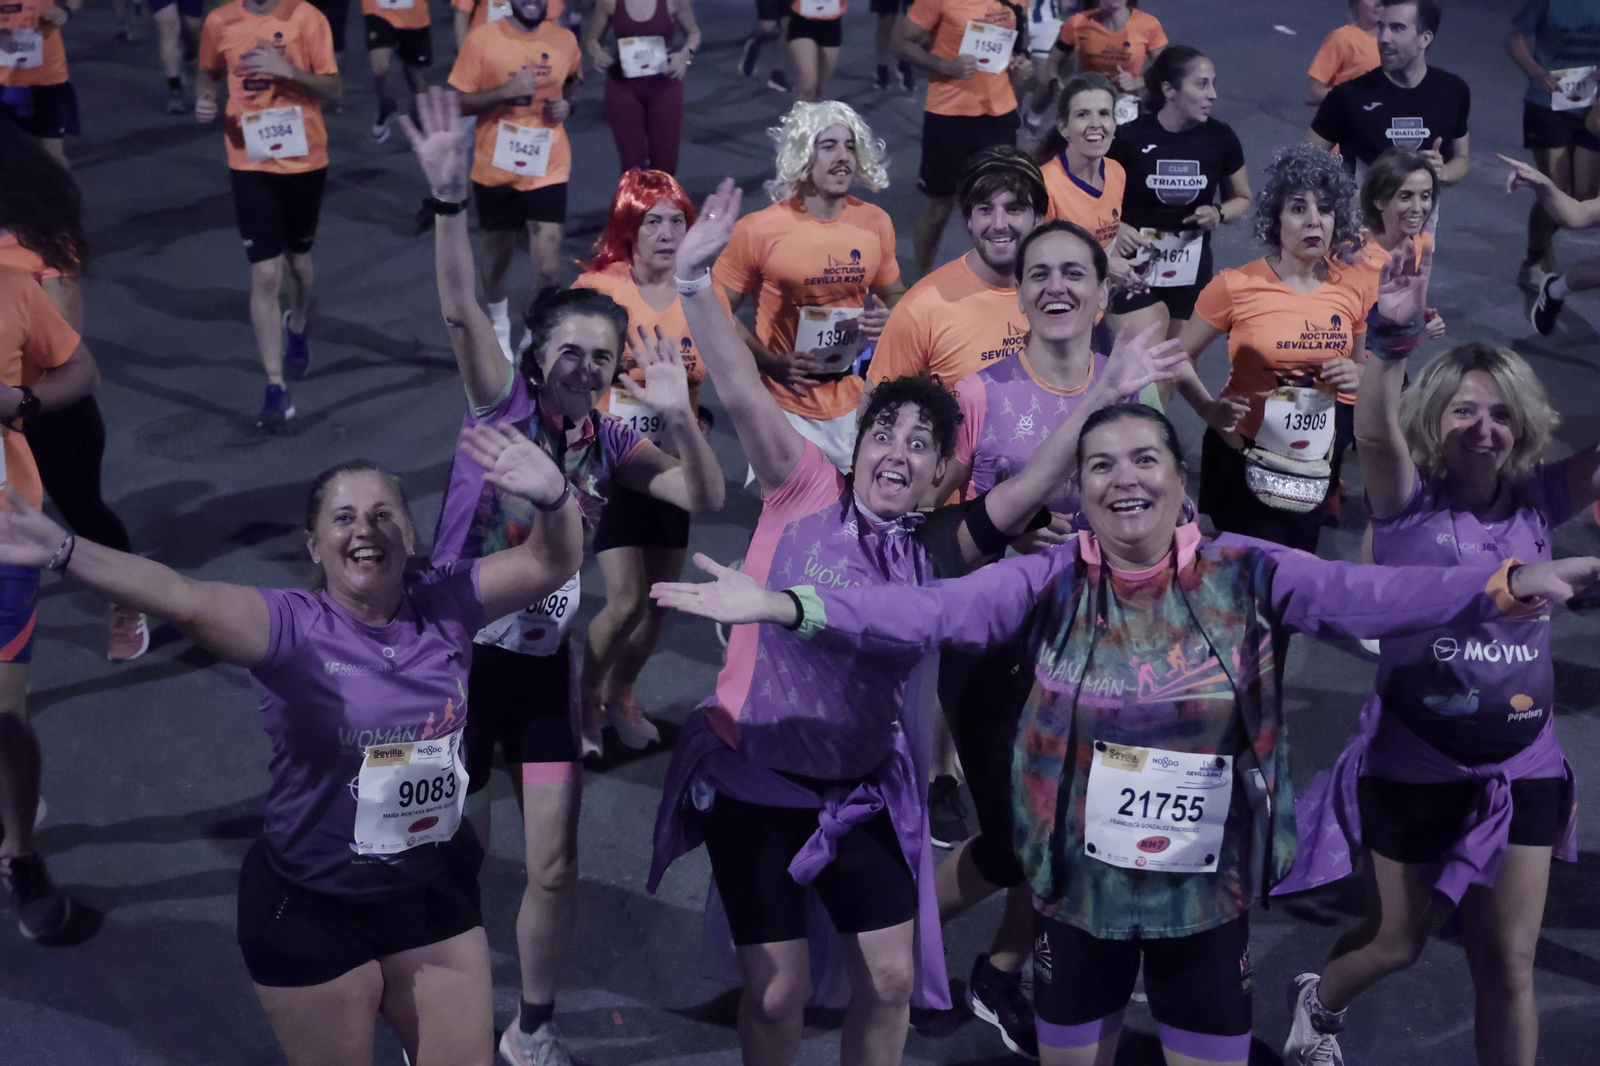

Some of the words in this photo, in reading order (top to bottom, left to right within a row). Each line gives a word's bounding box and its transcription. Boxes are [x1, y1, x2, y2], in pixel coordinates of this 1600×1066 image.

[975, 38, 1003, 54] 11549
[258, 124, 293, 140] 13384
[509, 140, 541, 156] 15424
[1169, 165, 1189, 173] CLUB
[1152, 177, 1203, 187] TRIATLÓN
[823, 266, 866, 275] NOCTURNA
[803, 276, 843, 287] SEVILLA
[1299, 332, 1348, 340] NOCTURNA
[1275, 341, 1323, 350] SEVILLA
[1284, 412, 1327, 431] 13909
[339, 722, 420, 749] WOMAN
[398, 772, 456, 808] 9083
[1118, 787, 1205, 823] 21755
[1109, 818, 1140, 829] FRANCISCA
